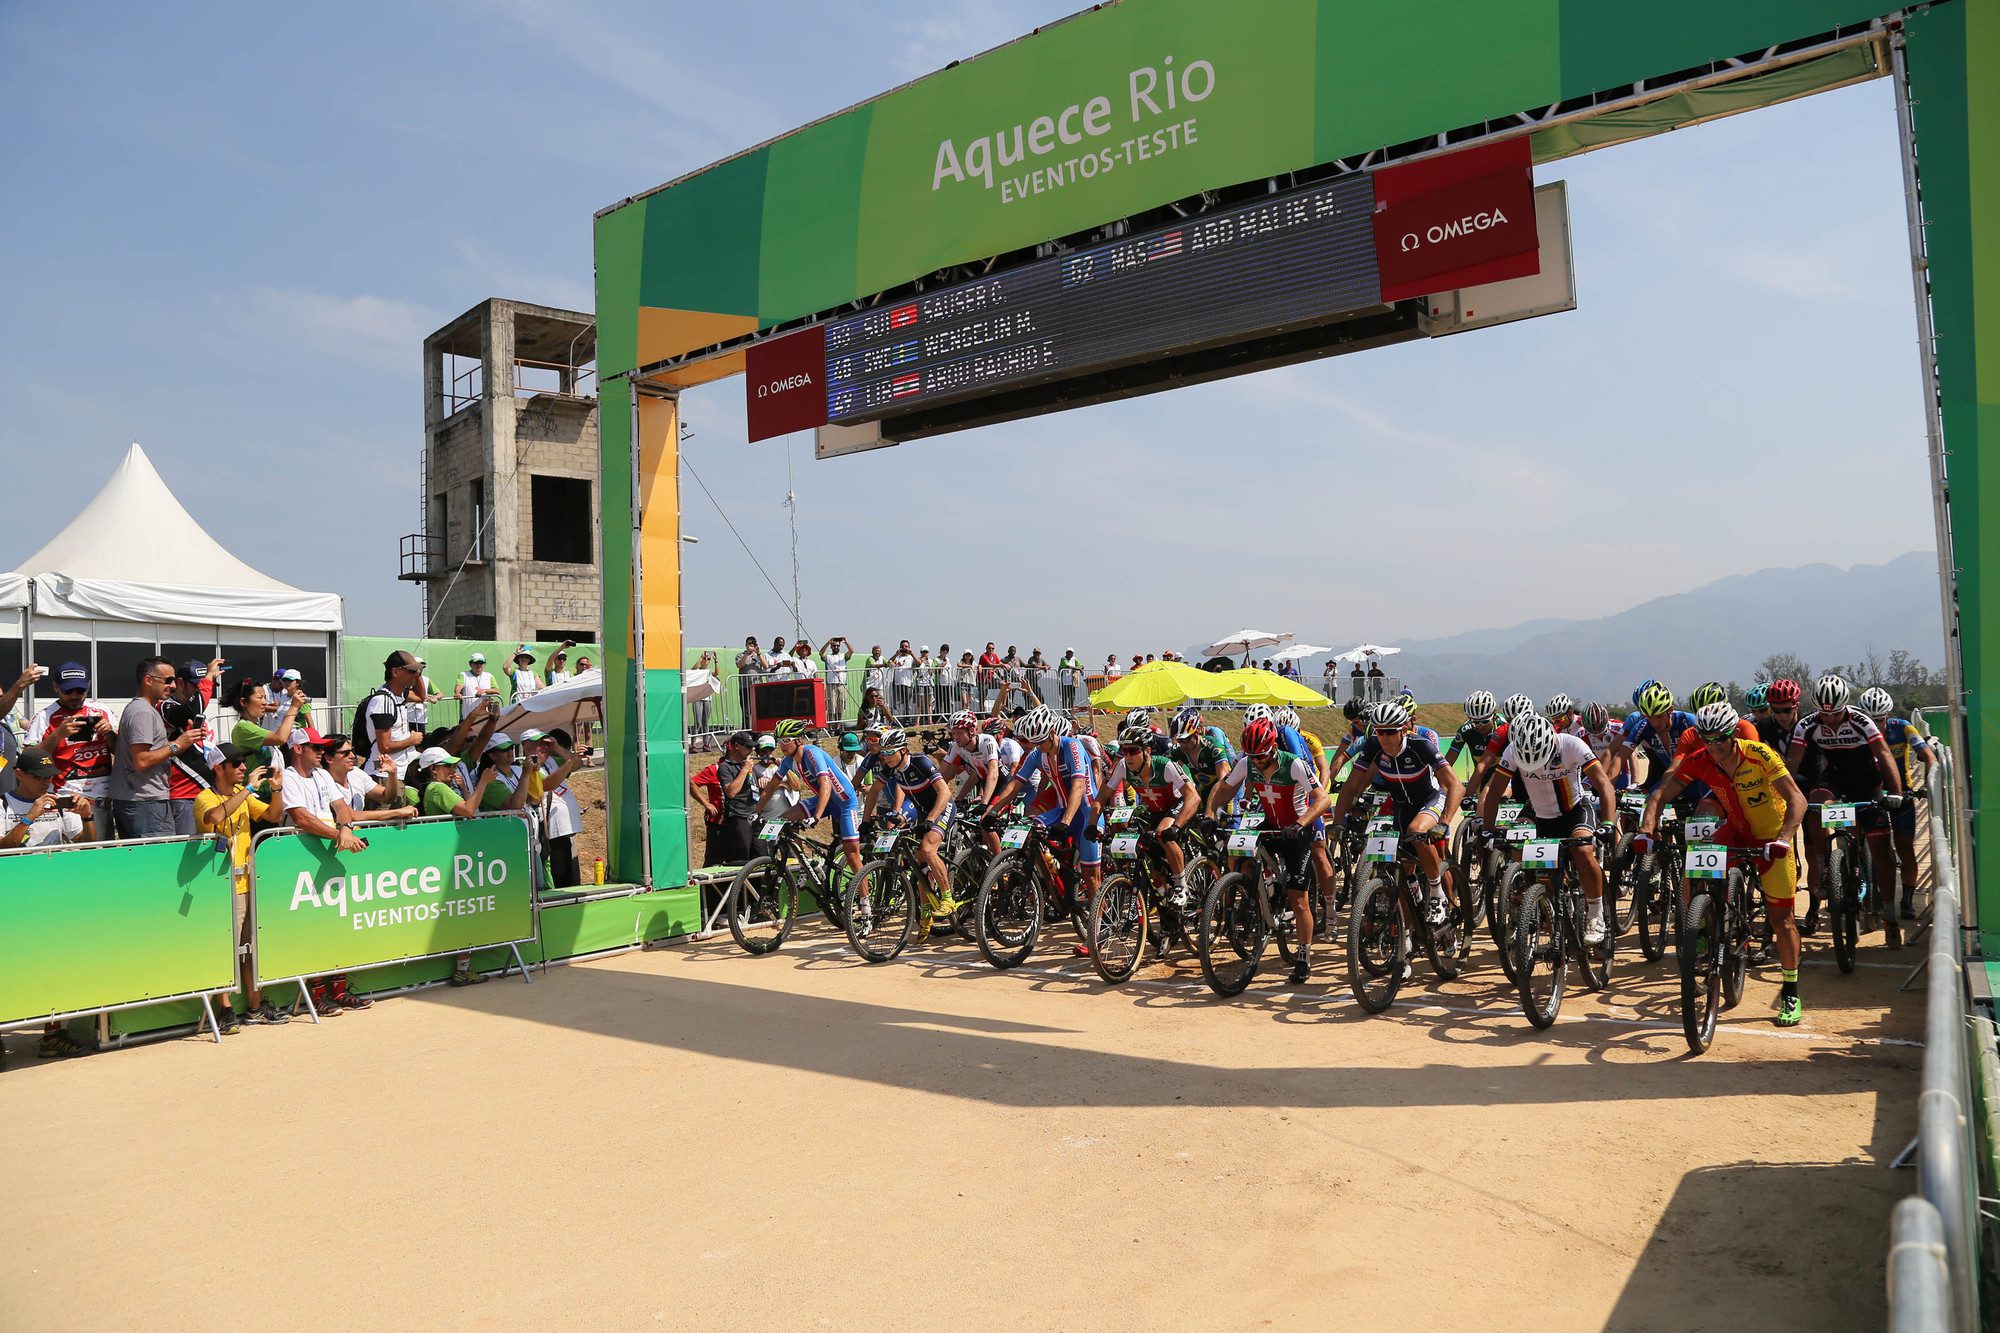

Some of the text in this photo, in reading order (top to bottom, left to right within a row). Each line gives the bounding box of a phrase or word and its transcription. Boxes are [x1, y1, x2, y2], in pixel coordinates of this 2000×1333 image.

[932, 55, 1215, 190] Aquece Rio
[1001, 118, 1197, 204] EVENTOS-TESTE
[1426, 207, 1508, 244] OMEGA
[770, 372, 812, 394] OMEGA
[1115, 810, 1128, 818] 26
[1500, 810, 1517, 819] 30
[1828, 810, 1848, 820] 21
[1245, 819, 1260, 828] 12
[767, 825, 775, 834] 8
[1692, 825, 1711, 838] 16
[1010, 831, 1018, 841] 4
[1513, 831, 1530, 840] 15
[881, 838, 888, 846] 6
[1119, 840, 1127, 851] 2
[1237, 837, 1246, 848] 3
[1377, 840, 1385, 852] 1
[1535, 846, 1545, 858] 5
[1694, 854, 1718, 868] 10
[289, 851, 507, 917] Aquece Rio
[353, 895, 496, 930] EVENTOS-TESTE
